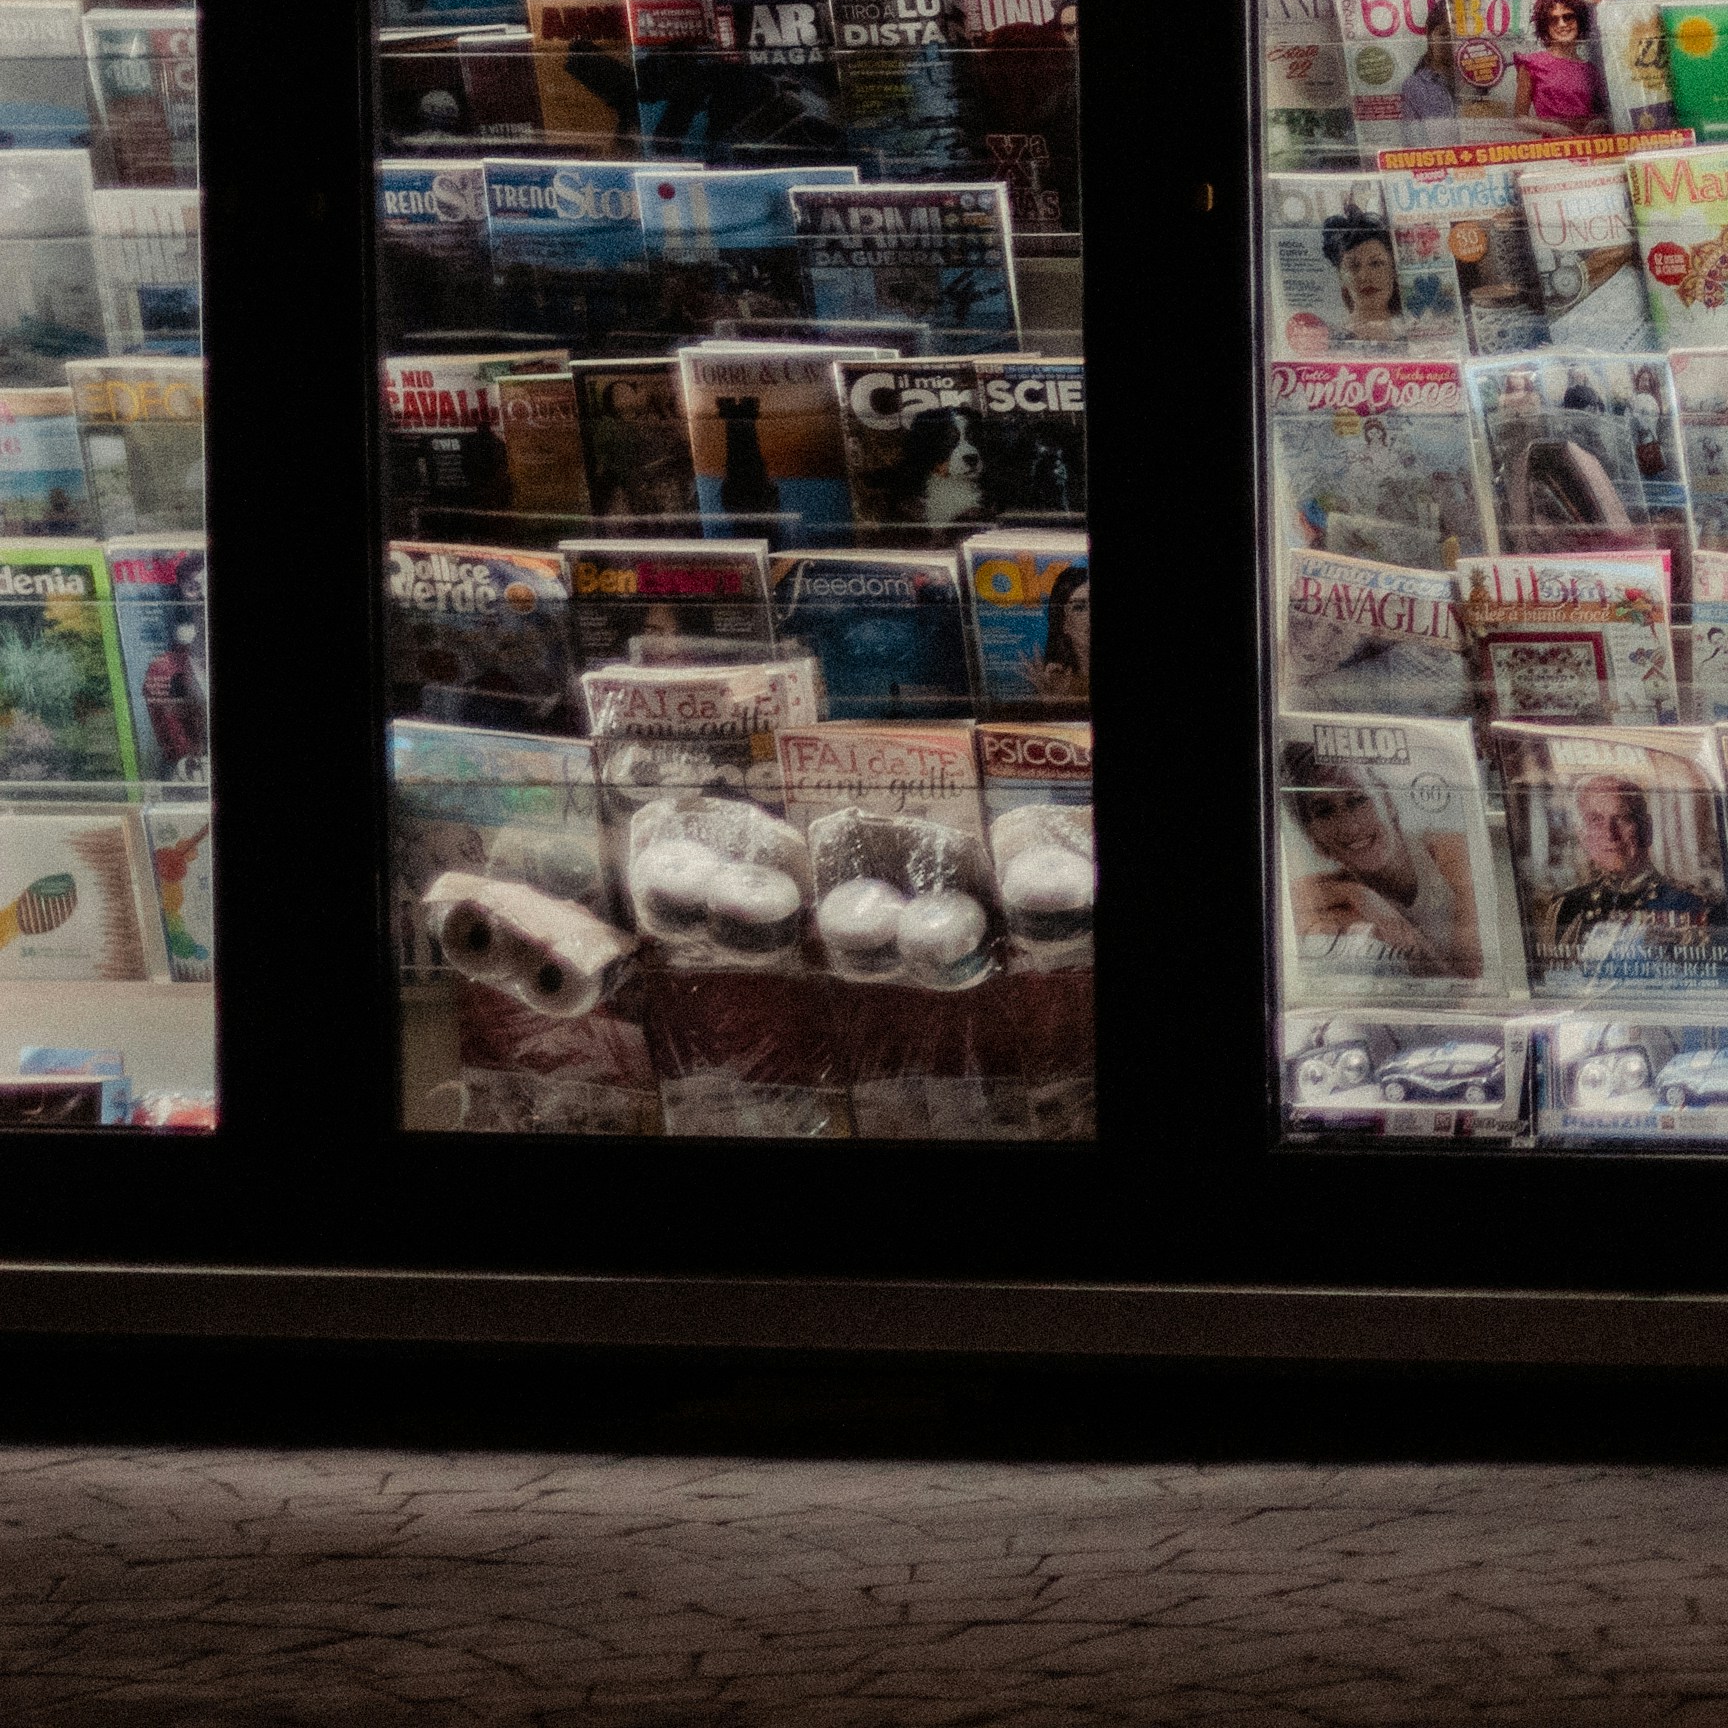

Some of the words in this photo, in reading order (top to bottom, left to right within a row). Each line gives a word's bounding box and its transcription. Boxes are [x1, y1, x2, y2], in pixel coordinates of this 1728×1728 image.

[491, 183, 555, 210] TRENO
[815, 206, 946, 249] ARMI
[815, 250, 847, 267] DA
[851, 249, 946, 267] GUERRA
[1315, 725, 1409, 760] HELLO!
